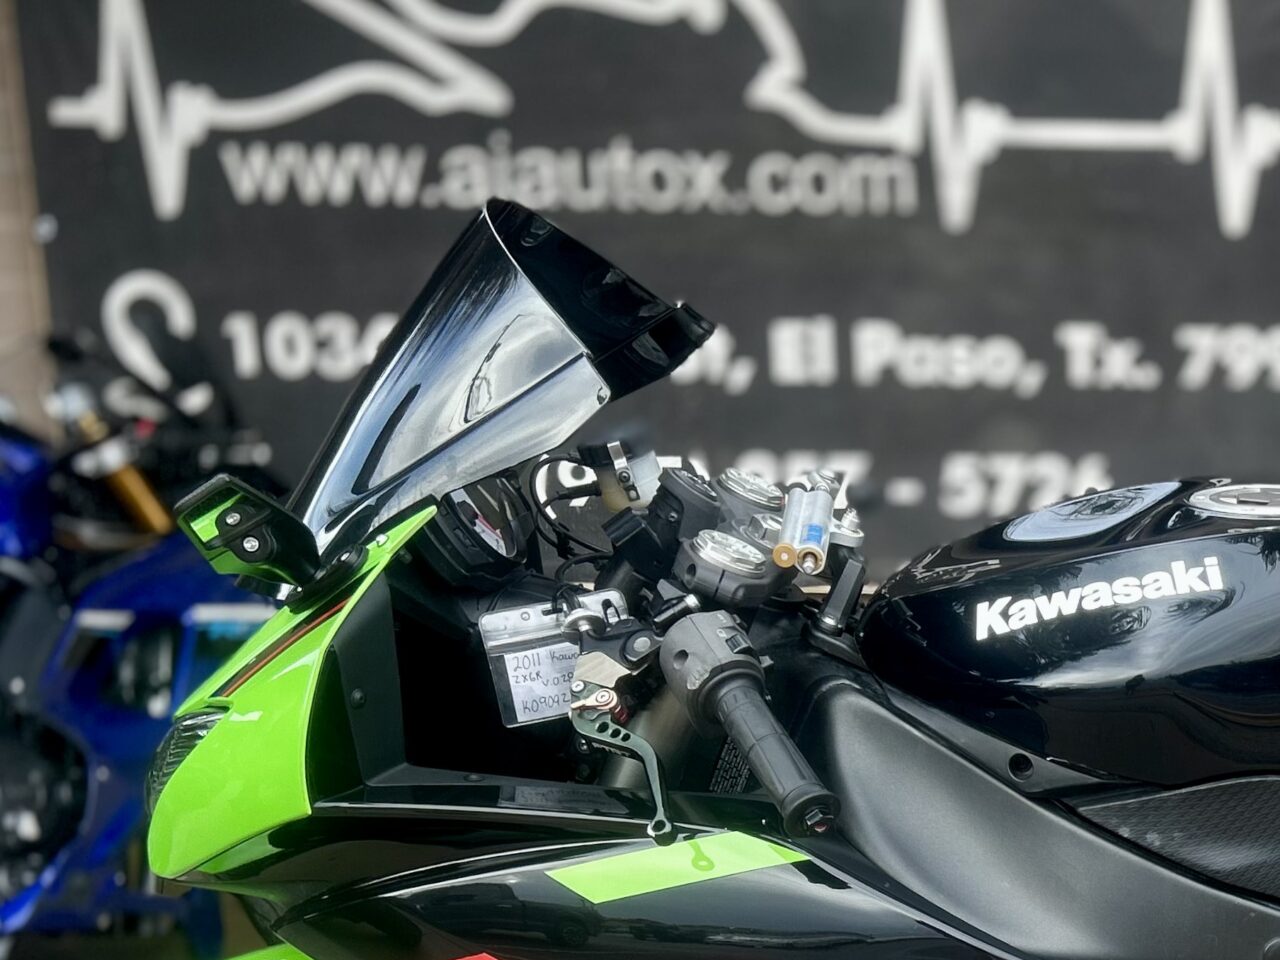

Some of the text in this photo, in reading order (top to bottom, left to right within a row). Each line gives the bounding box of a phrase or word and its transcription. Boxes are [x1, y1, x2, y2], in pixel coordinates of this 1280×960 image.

[768, 314, 839, 387] El
[851, 317, 1049, 399] Paso,
[1053, 320, 1162, 391] Tx.
[974, 555, 1224, 641] Kawasaki
[512, 653, 541, 672] 2011
